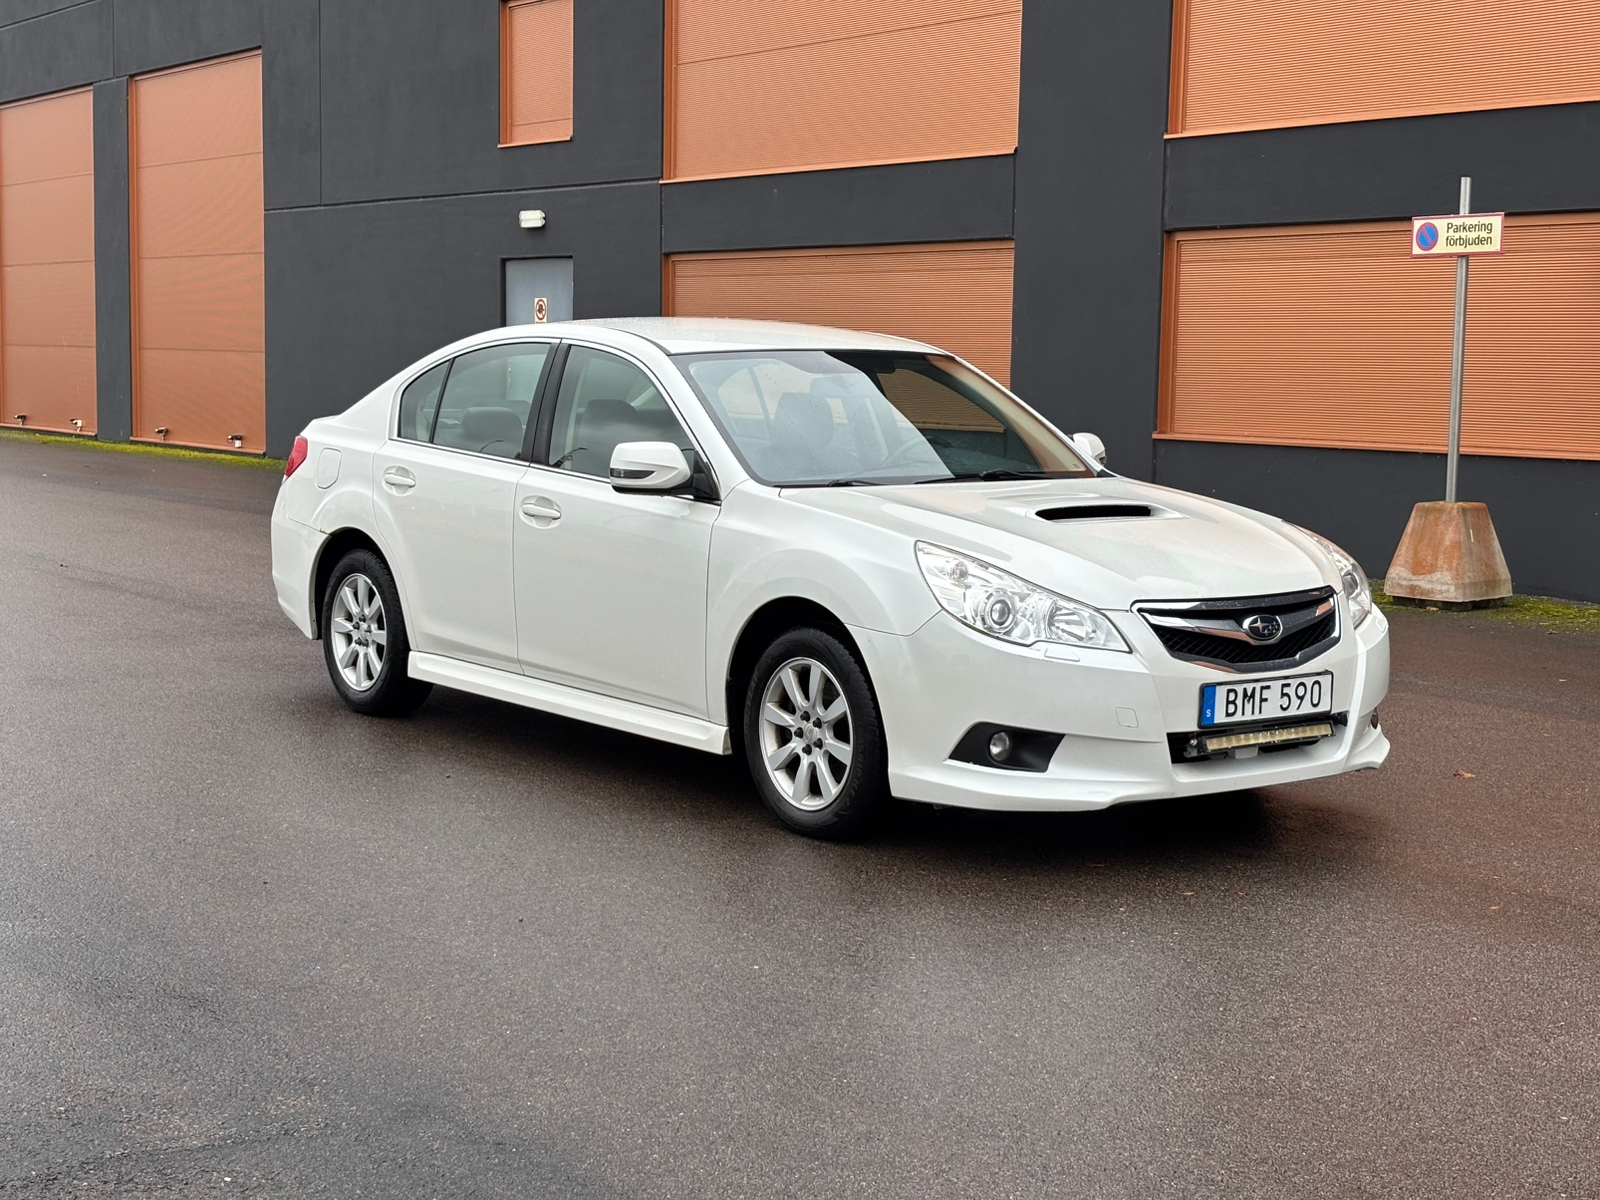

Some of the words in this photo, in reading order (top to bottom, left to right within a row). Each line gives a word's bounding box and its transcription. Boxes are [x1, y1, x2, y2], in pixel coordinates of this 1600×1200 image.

[1446, 221, 1493, 234] Parkering
[1446, 235, 1492, 248] förbjuden
[1225, 685, 1271, 717] BMF
[1280, 680, 1322, 711] 590
[1206, 709, 1212, 717] S
